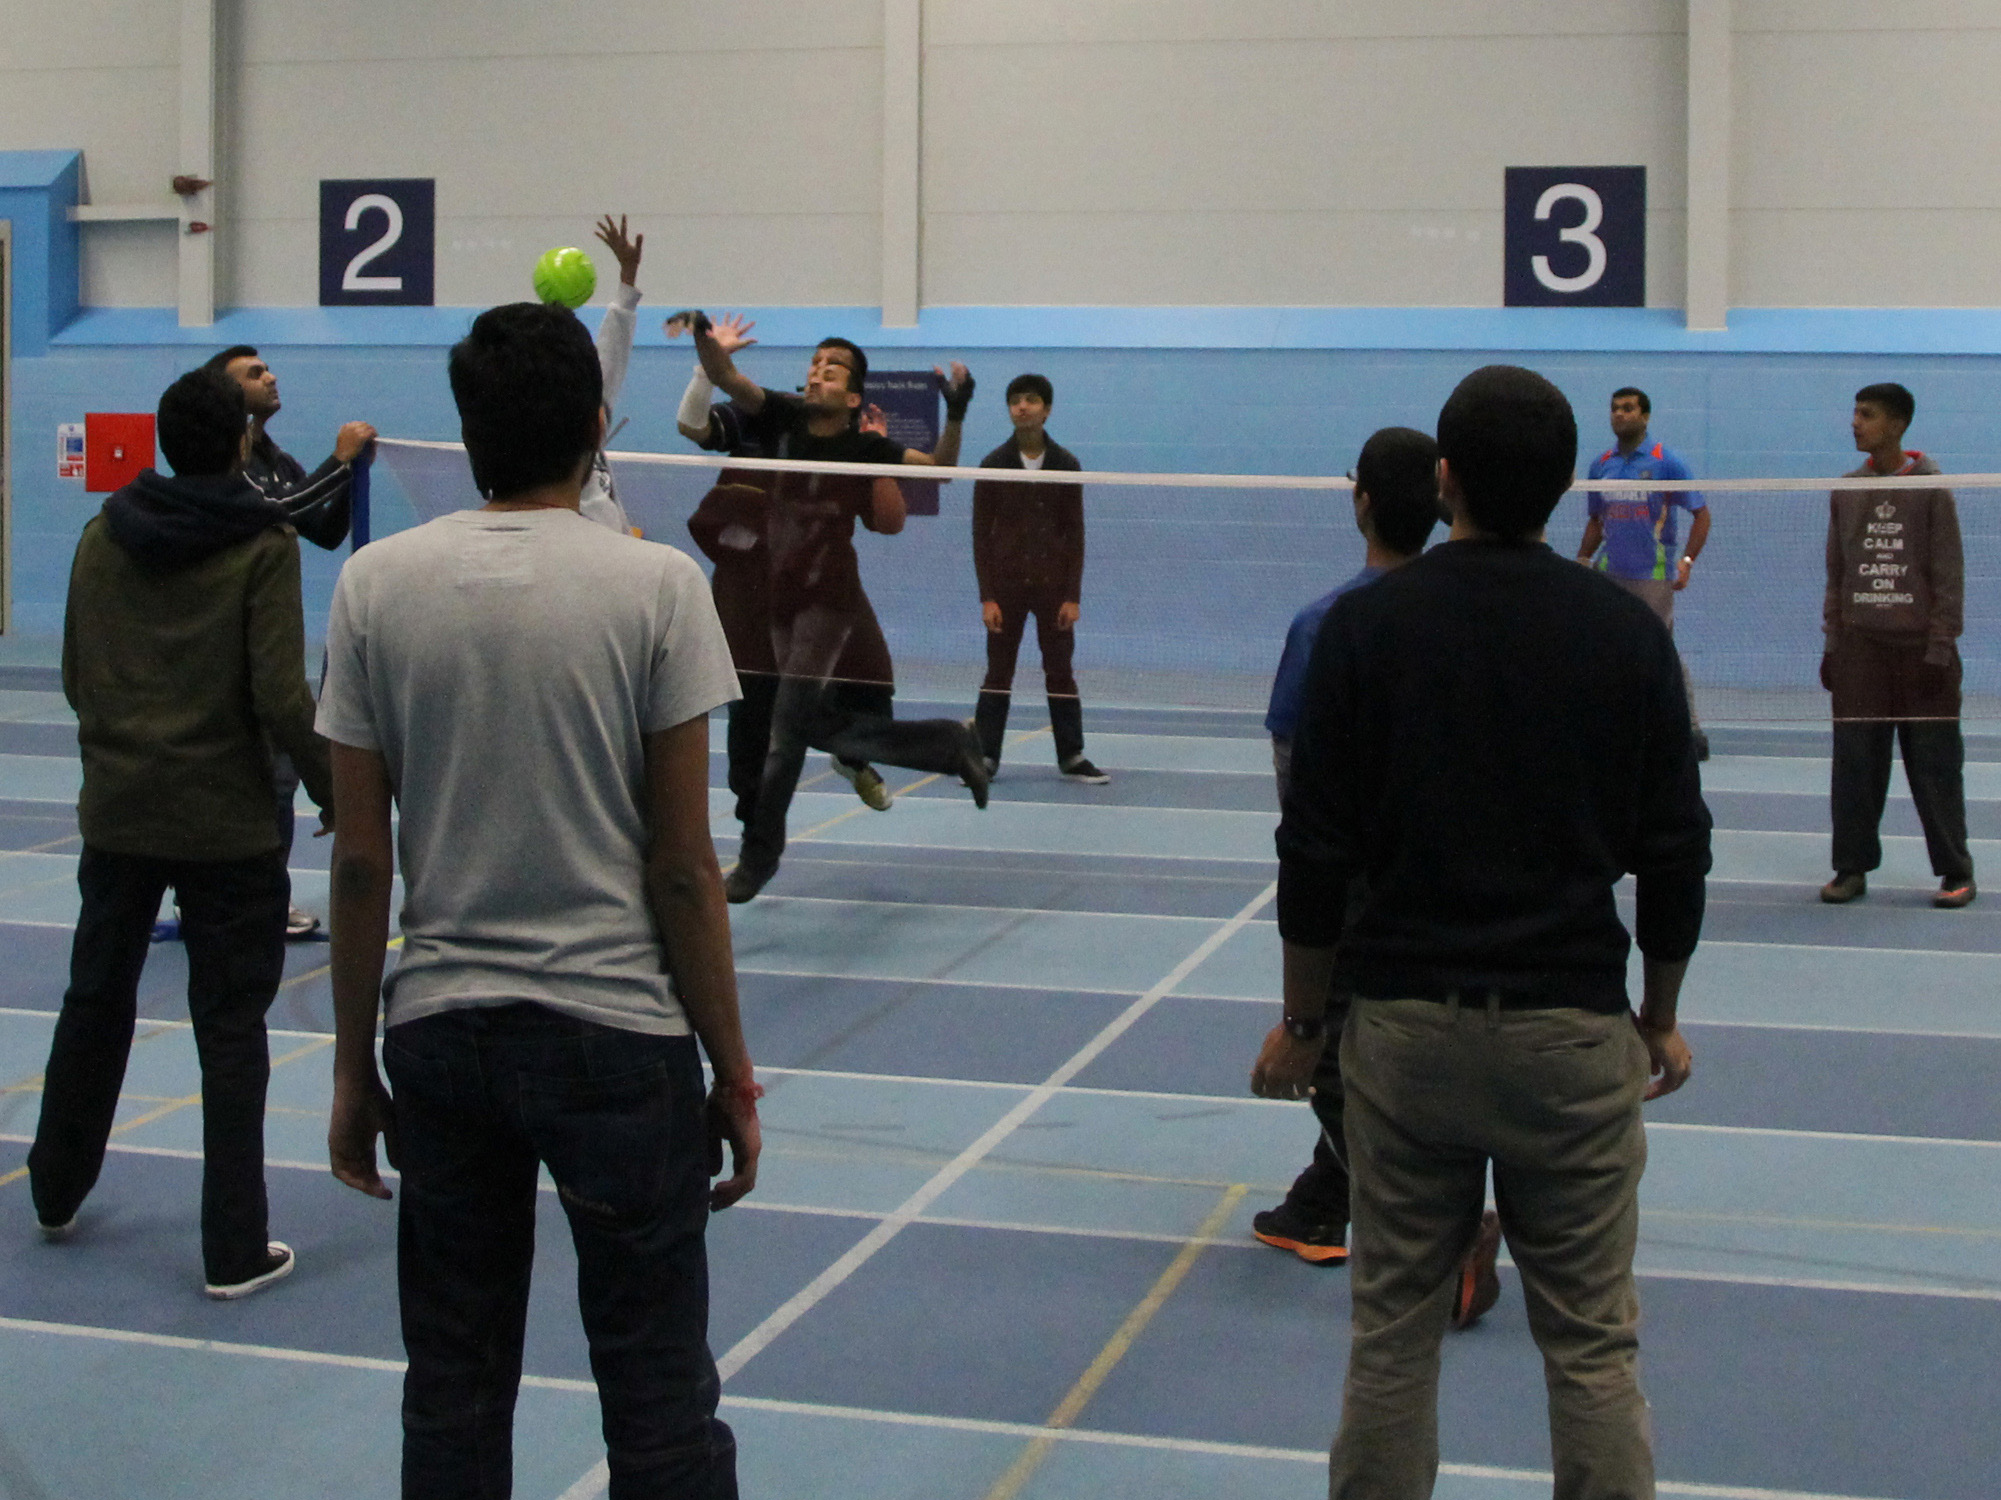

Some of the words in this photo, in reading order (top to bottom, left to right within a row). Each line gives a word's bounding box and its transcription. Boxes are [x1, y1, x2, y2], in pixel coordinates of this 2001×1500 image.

[342, 193, 403, 290] 2
[1531, 183, 1607, 293] 3
[1867, 523, 1903, 534] KEEP
[1863, 538, 1904, 550] CALM
[1859, 564, 1908, 576] CARRY
[1872, 578, 1895, 590] ON
[1853, 592, 1914, 603] DRINKING
